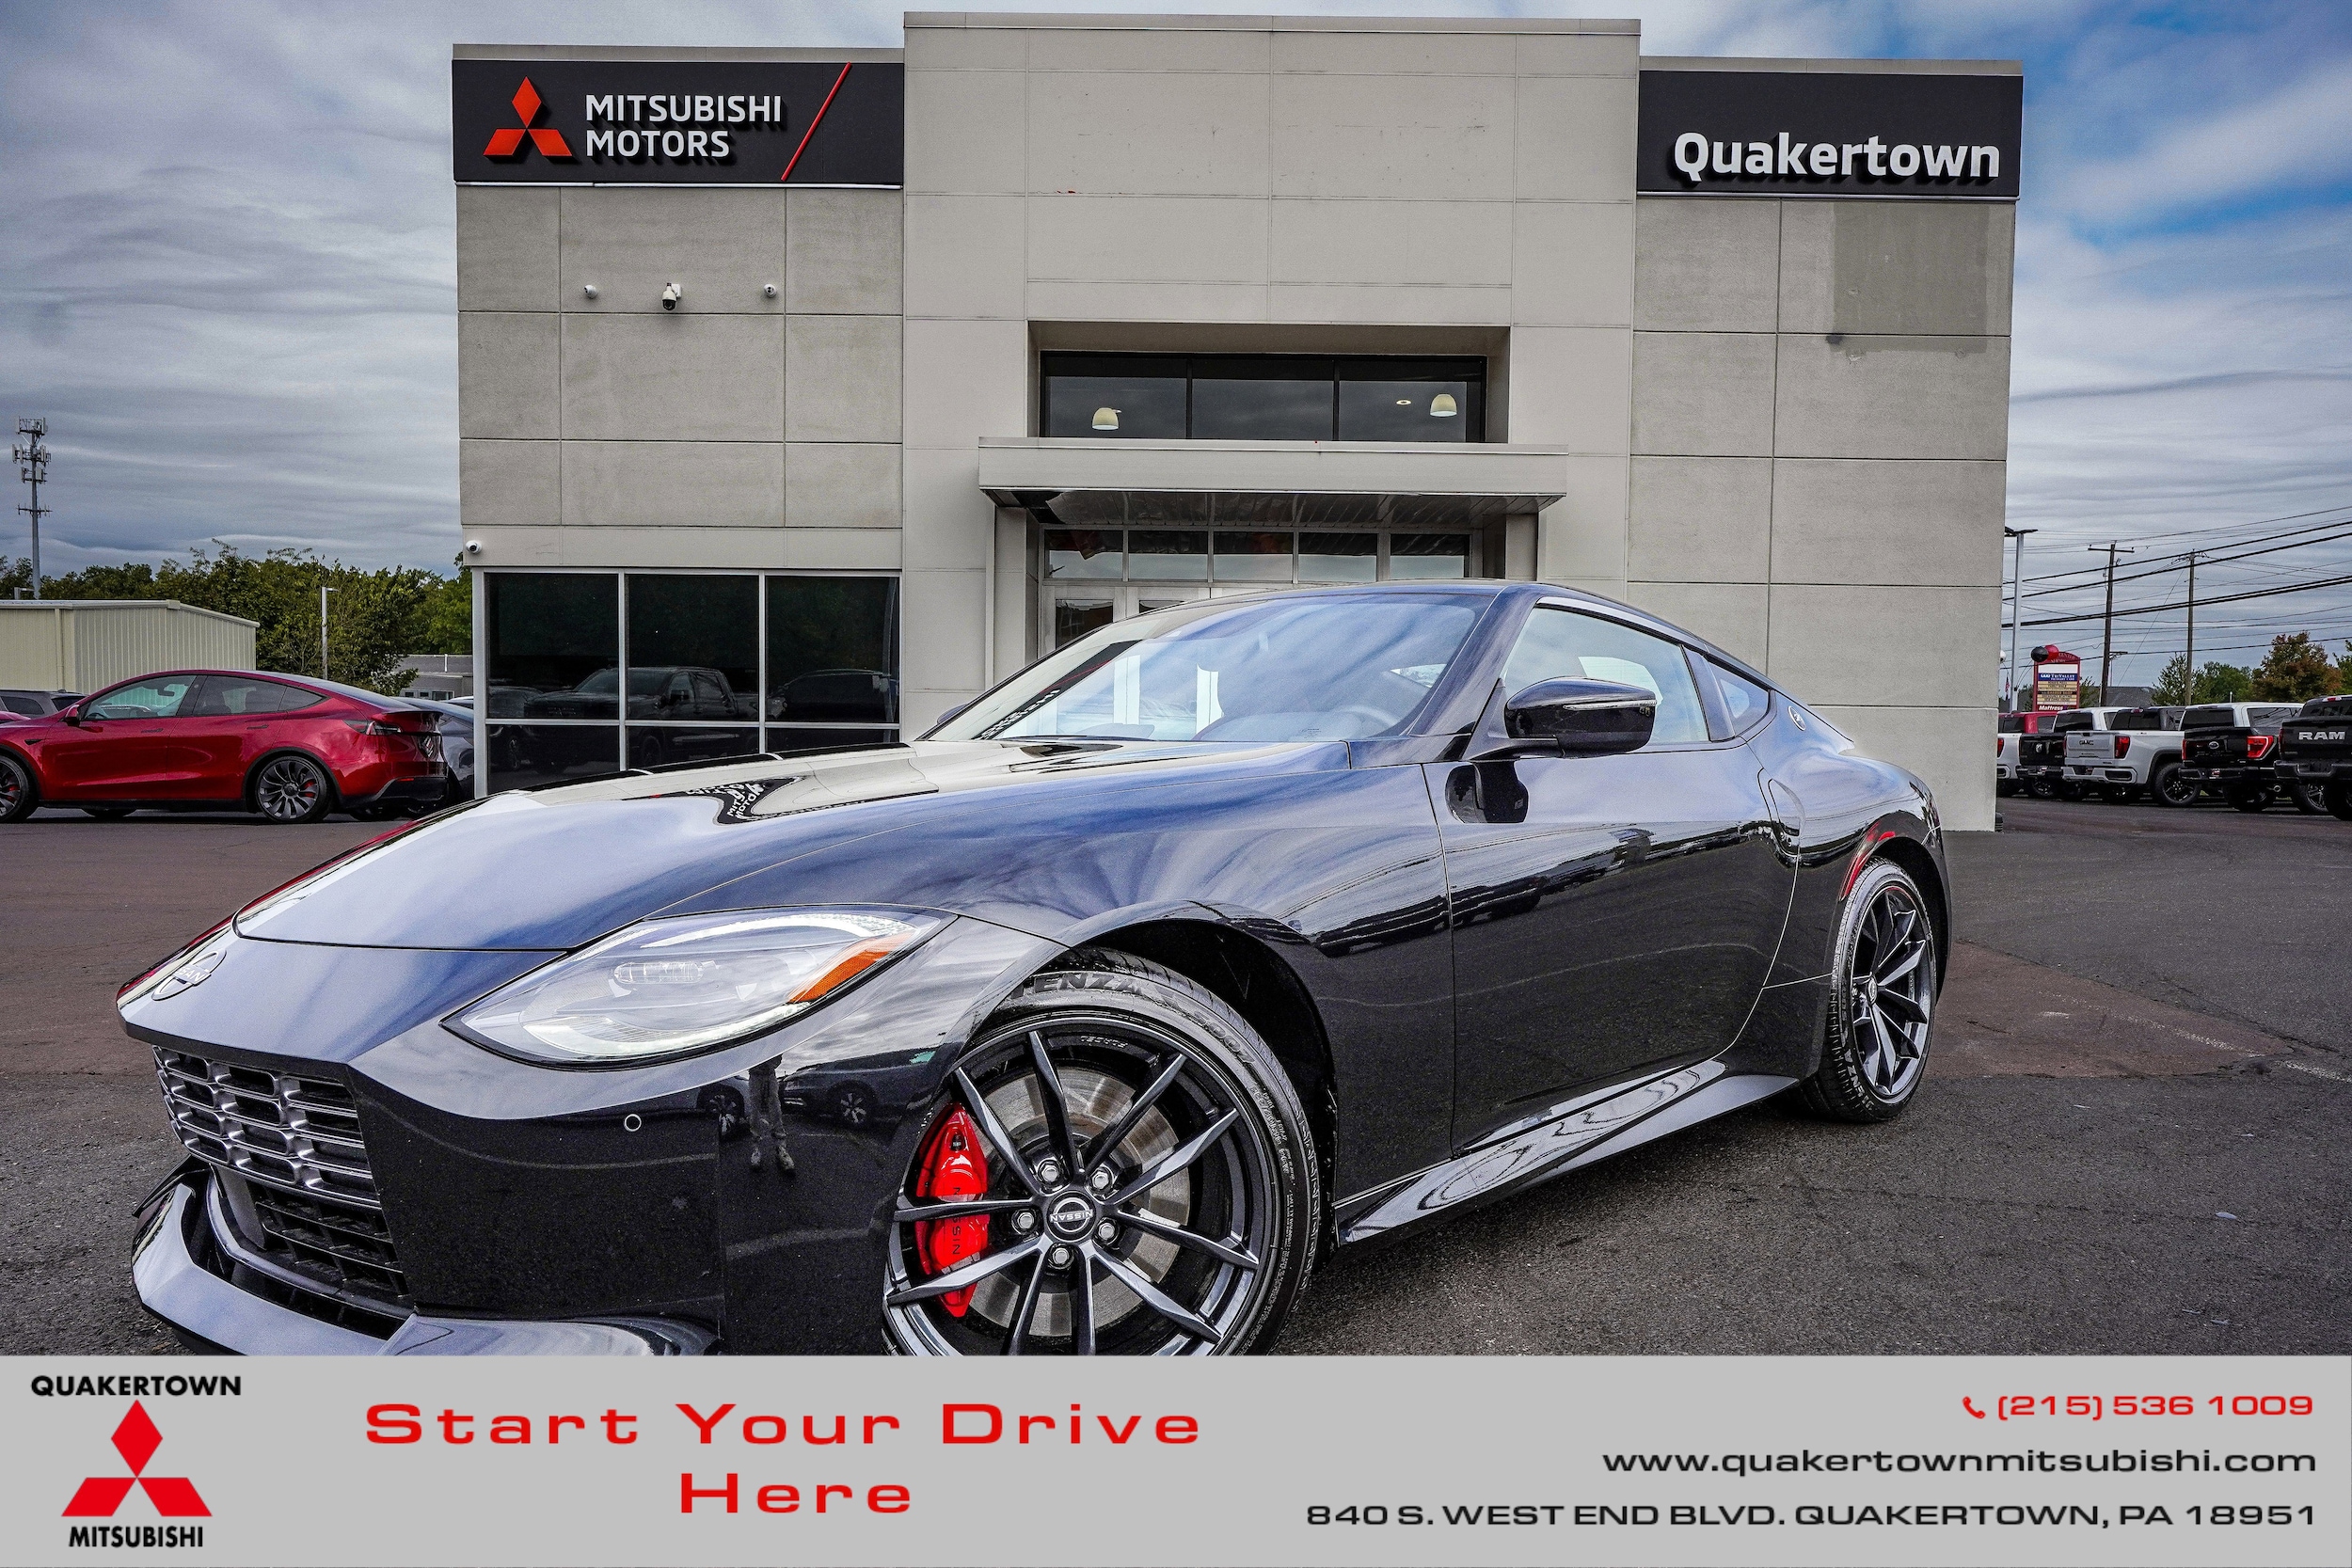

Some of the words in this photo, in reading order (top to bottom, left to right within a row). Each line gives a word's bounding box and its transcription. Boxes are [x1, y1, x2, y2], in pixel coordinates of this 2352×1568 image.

[586, 94, 782, 122] MITSUBISHI
[586, 130, 730, 157] MOTORS
[1674, 132, 2000, 182] Quakertown
[2298, 731, 2345, 740] RAM
[1049, 1209, 1094, 1222] NISSAN
